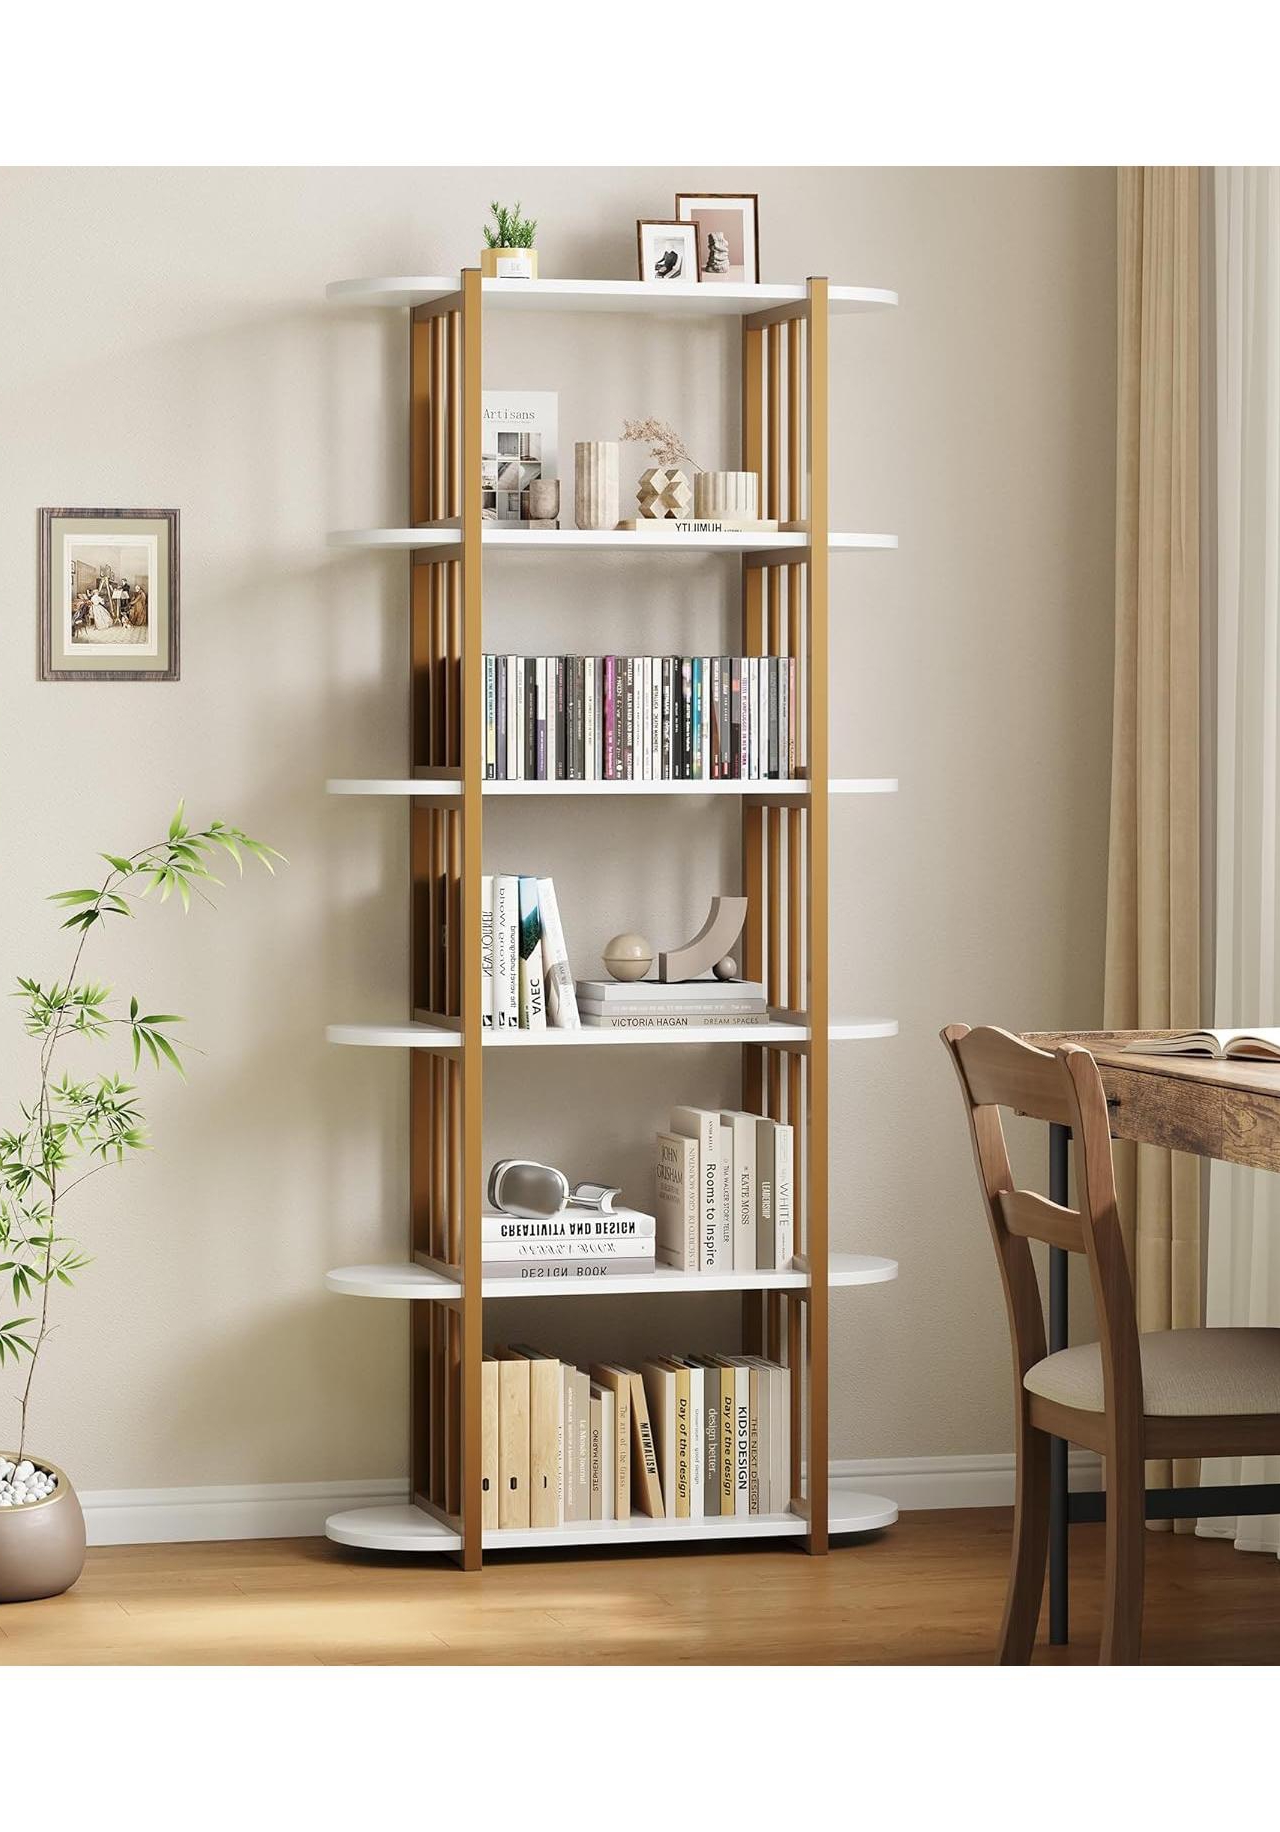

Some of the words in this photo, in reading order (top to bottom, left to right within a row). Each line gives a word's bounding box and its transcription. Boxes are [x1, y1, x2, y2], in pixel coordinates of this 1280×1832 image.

[483, 408, 535, 420] Artisans
[611, 1018, 654, 1027] VICTORIA
[656, 1018, 688, 1027] HAGAN
[706, 1164, 716, 1204] Rooms
[741, 1174, 749, 1197] KATE
[761, 1181, 771, 1219] LEADERSHIP
[779, 1183, 789, 1226] WHITE
[706, 1208, 716, 1220] to
[741, 1200, 749, 1225] MOSS
[704, 1224, 717, 1265] Inspire
[619, 1406, 627, 1418] The
[678, 1399, 687, 1421] Day
[723, 1396, 732, 1419] Day
[619, 1422, 627, 1434] art
[680, 1424, 687, 1436] of
[706, 1408, 718, 1441] design
[724, 1421, 732, 1434] of
[738, 1406, 747, 1437] KIDS
[620, 1438, 627, 1447] of
[640, 1422, 656, 1475] MINIMALISM
[724, 1436, 732, 1455] the
[619, 1452, 627, 1463] the
[708, 1443, 718, 1480] better...
[738, 1441, 747, 1490] DESIGN
[578, 1457, 587, 1484] Journal
[678, 1461, 687, 1498] design
[723, 1459, 732, 1496] design
